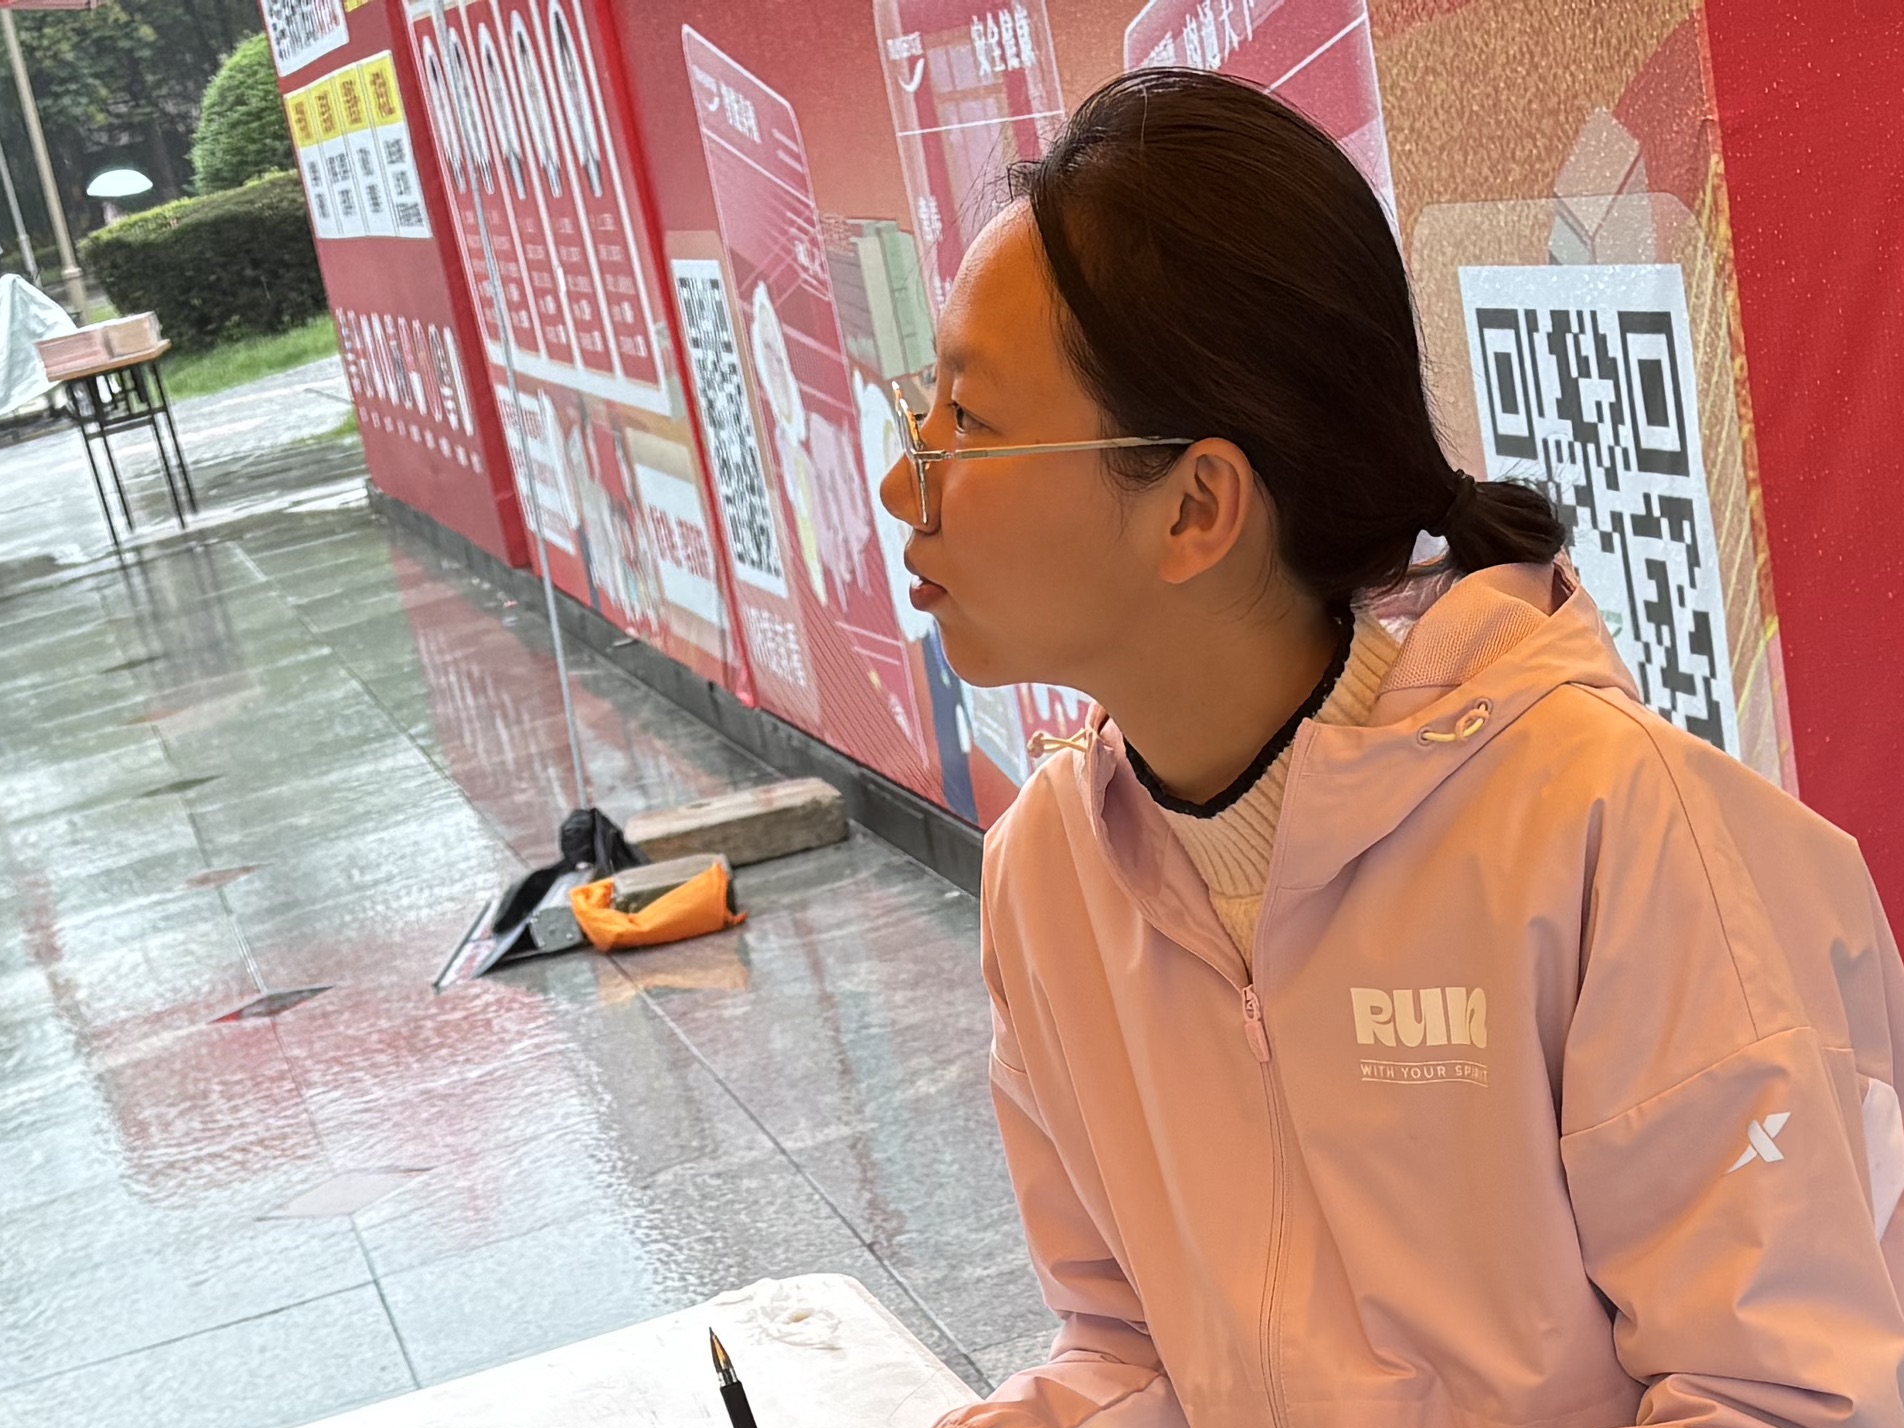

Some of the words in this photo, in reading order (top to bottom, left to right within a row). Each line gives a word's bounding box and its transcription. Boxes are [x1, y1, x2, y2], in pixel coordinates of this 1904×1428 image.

[1360, 1063, 1395, 1079] WITH
[1400, 1065, 1447, 1079] YOUR
[1455, 1064, 1488, 1082] SPIRIT
